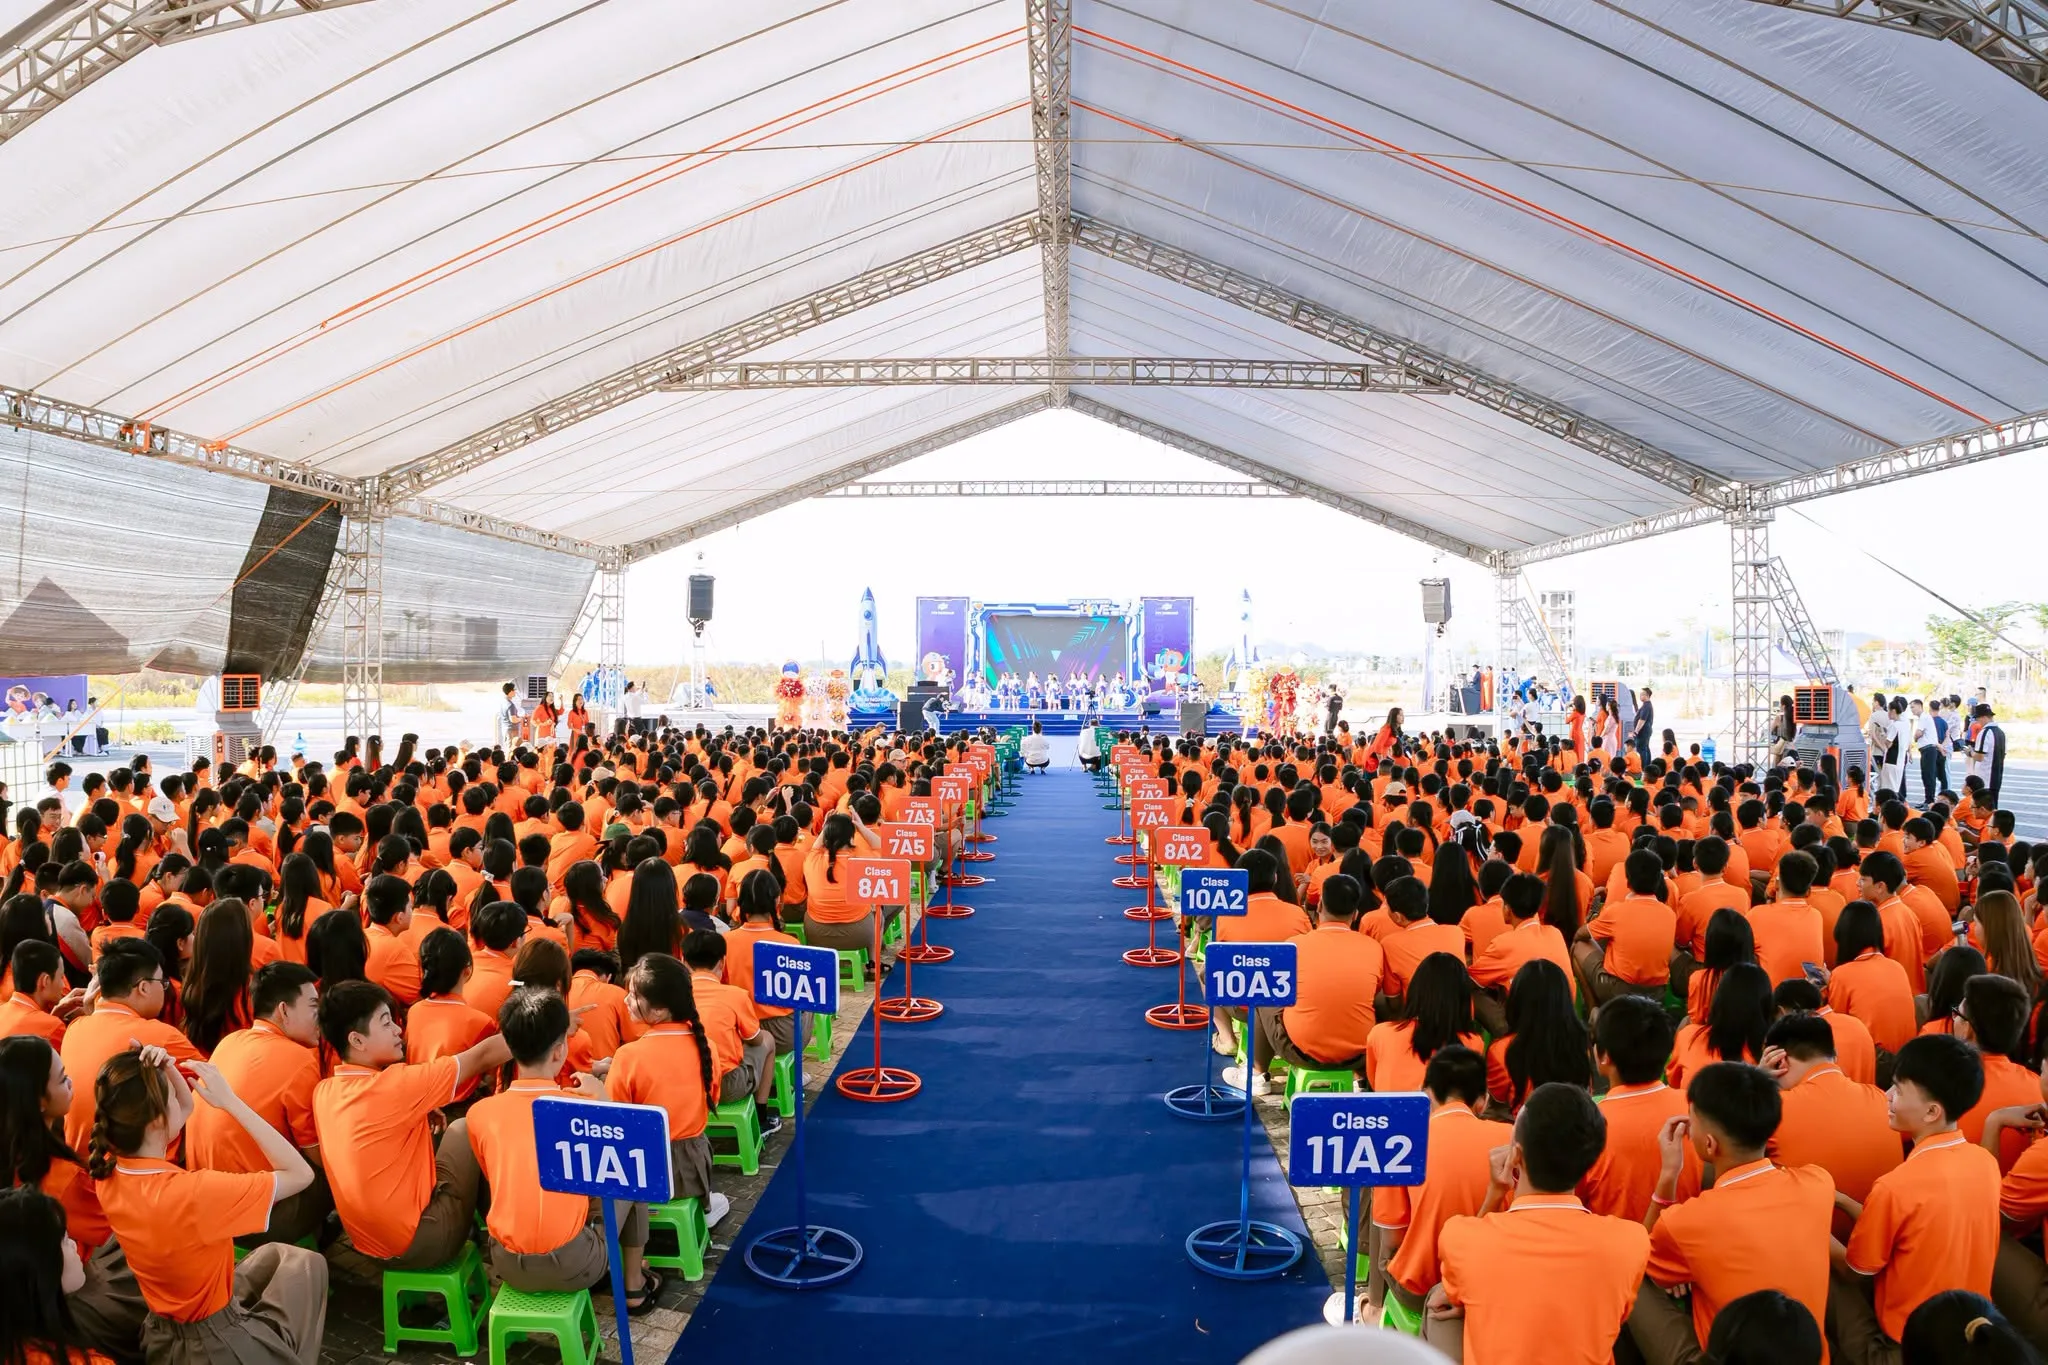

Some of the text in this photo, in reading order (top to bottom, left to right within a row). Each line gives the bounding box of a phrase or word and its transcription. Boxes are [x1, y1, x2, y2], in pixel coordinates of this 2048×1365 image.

[938, 788, 961, 800] 7A1
[1136, 790, 1163, 798] 7A2
[905, 809, 935, 823] 7A3
[1136, 811, 1169, 825] 7A4
[895, 829, 918, 837] Class
[1172, 833, 1195, 841] Class
[888, 838, 925, 855] 7A5
[1164, 843, 1203, 860] 8A2
[864, 866, 892, 877] Class
[858, 878, 899, 899] 8A1
[1201, 877, 1229, 887] Class
[1186, 888, 1244, 910] 10A2
[776, 955, 812, 971] Class
[1232, 954, 1271, 967] Class
[761, 969, 827, 1004] 10A1
[1212, 970, 1291, 998] 10A3
[1332, 1111, 1389, 1129] Class
[570, 1117, 625, 1140] Class
[1306, 1135, 1413, 1174] 11A2
[555, 1140, 647, 1188] 11A1
